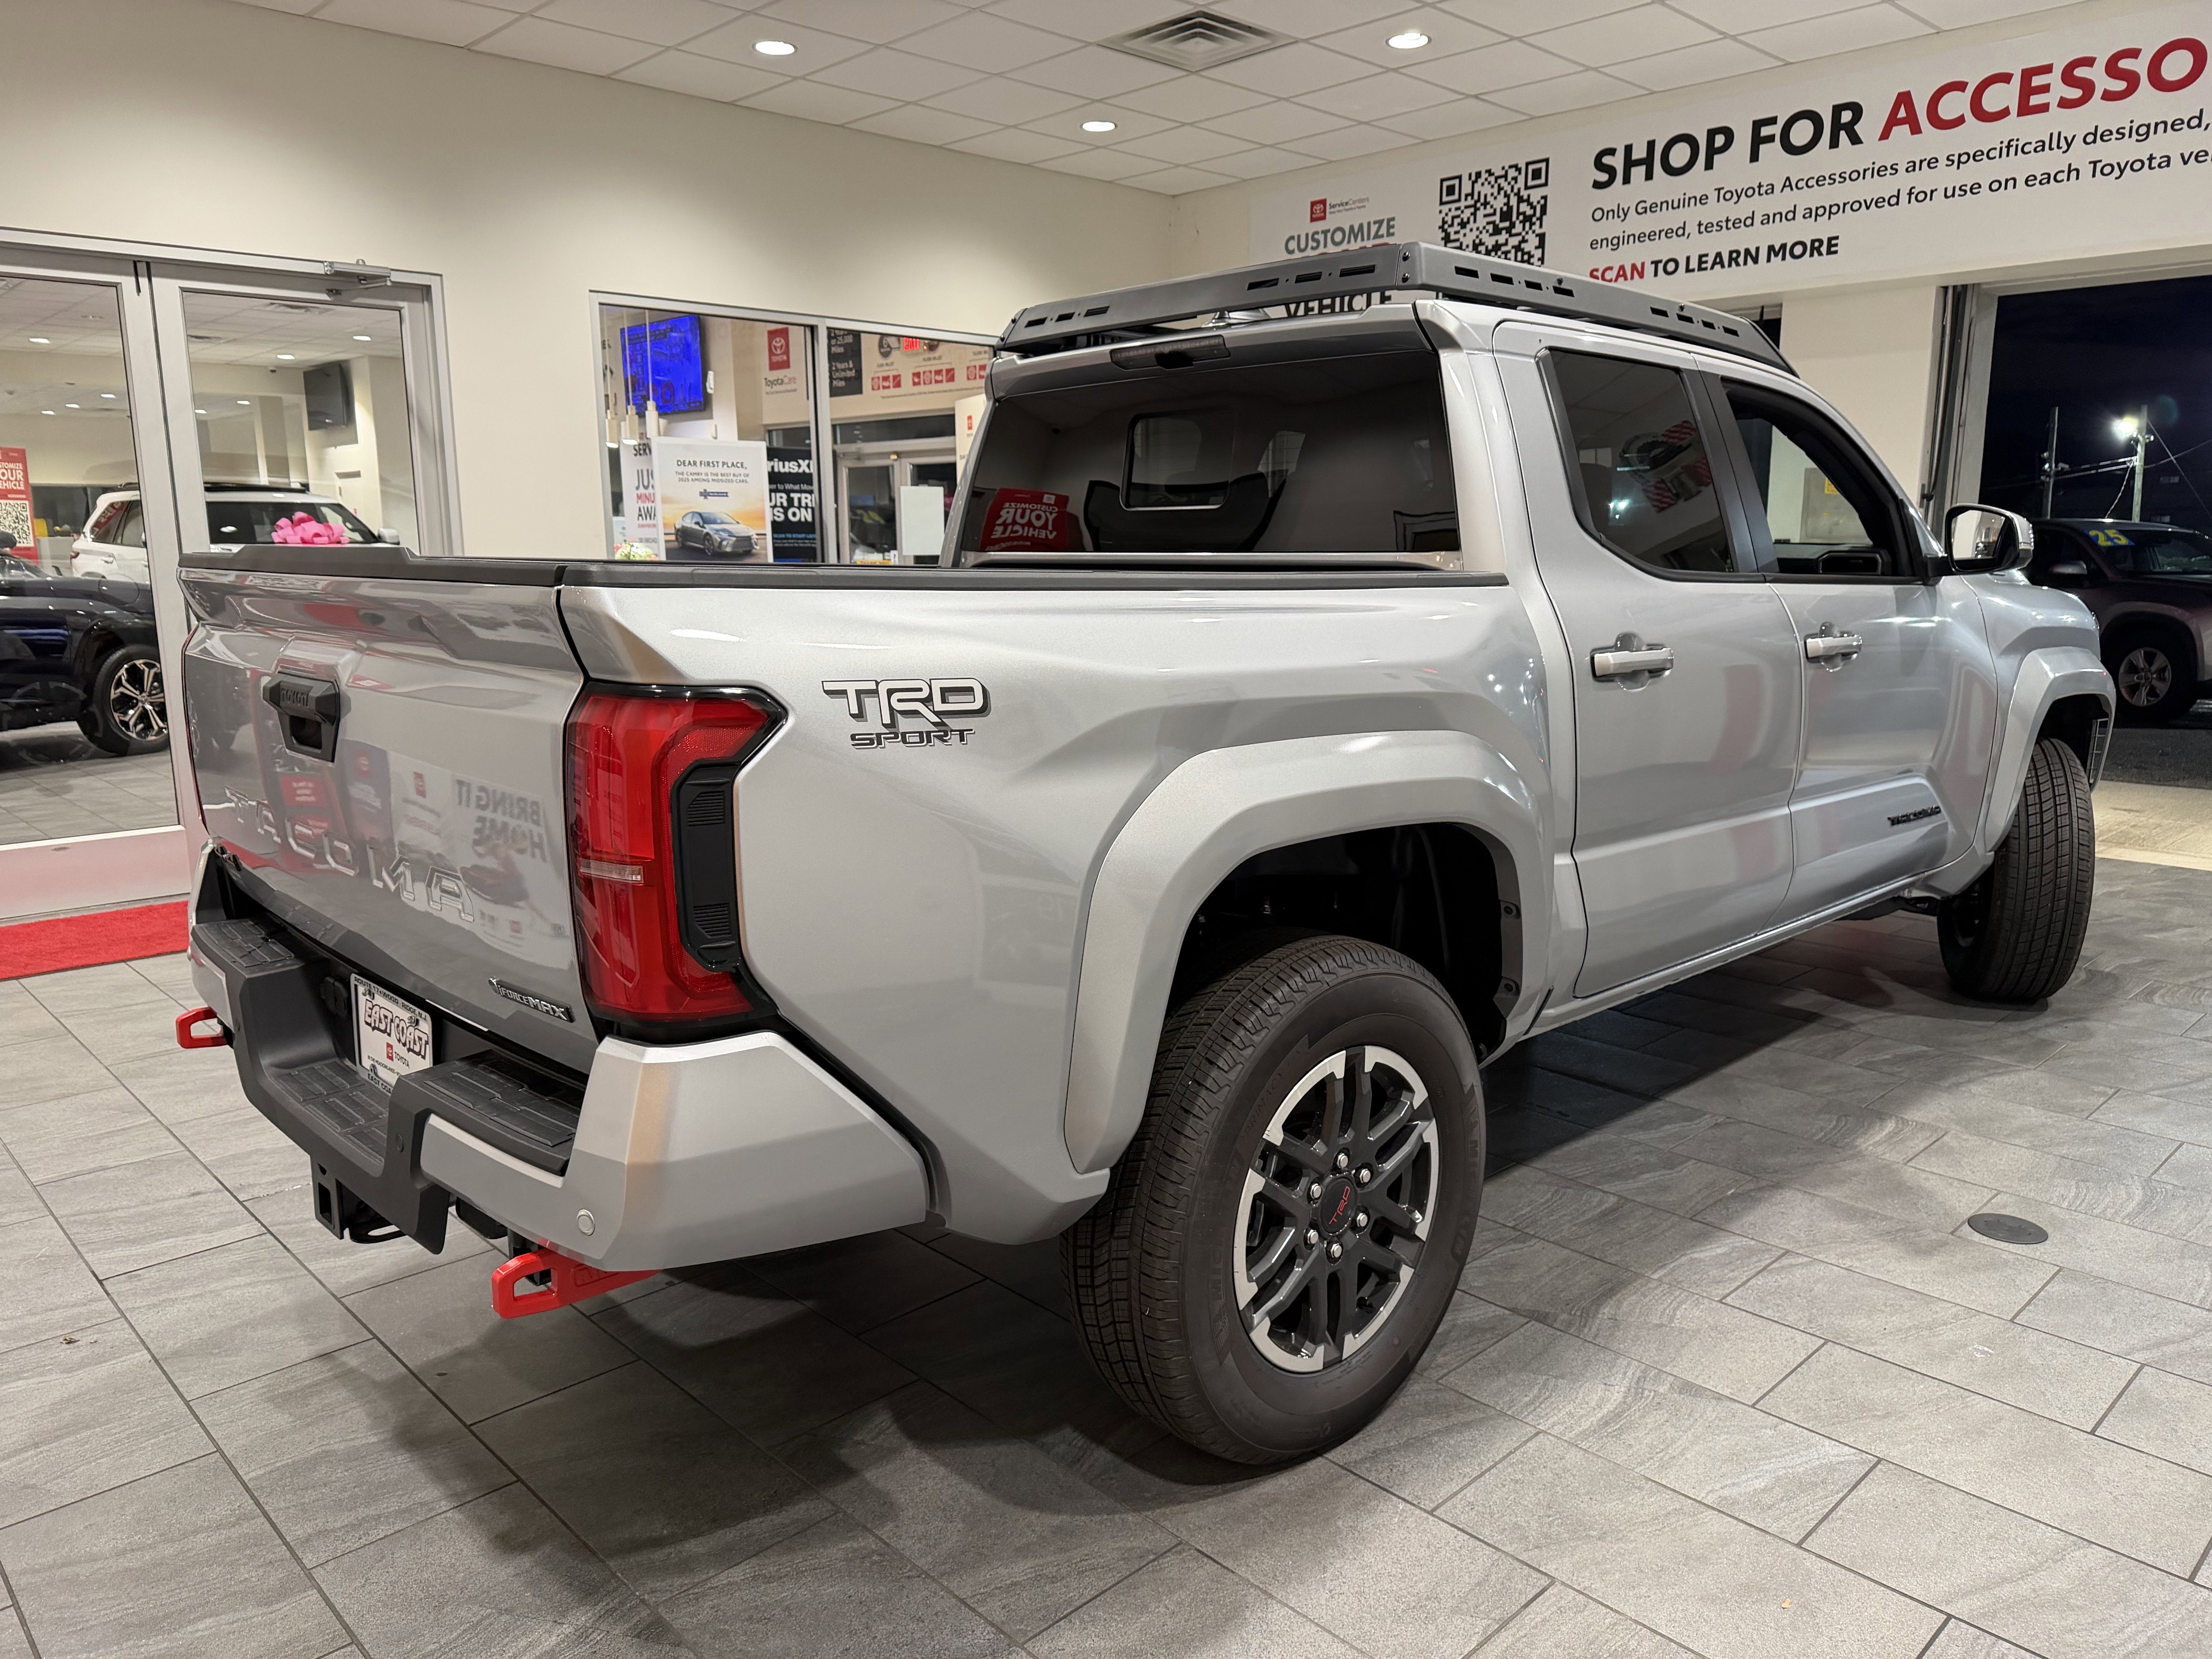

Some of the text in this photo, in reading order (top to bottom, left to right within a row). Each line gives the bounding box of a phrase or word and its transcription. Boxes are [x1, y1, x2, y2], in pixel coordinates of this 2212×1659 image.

[1592, 37, 2208, 189] SHOP FOR ACCESSO
[1592, 108, 2211, 222] Only Genuine Toyota Accessories are specifically designed,
[1329, 197, 1370, 209] ServiceCenters
[1590, 148, 2212, 251] engineered, tested and approved for use on each Toyota ve
[1285, 216, 1396, 255] CUSTOMIZE
[1589, 235, 1839, 283] SCAN TO LEARN MORE
[1285, 291, 1392, 316] VEHICLE
[722, 461, 747, 469] PLACE,
[787, 508, 812, 522] ON
[2088, 529, 2128, 546] 25
[821, 678, 991, 732] TRD
[850, 728, 975, 749] SPORT
[225, 785, 475, 923] TACOMA
[354, 977, 372, 988] ROUTE
[402, 1002, 417, 1017] RIDGE,
[364, 999, 429, 1060] EAST COAST
[394, 1051, 410, 1069] TOYOTA
[368, 1073, 393, 1094] EAST COA
[1329, 1186, 1350, 1225] TRD
